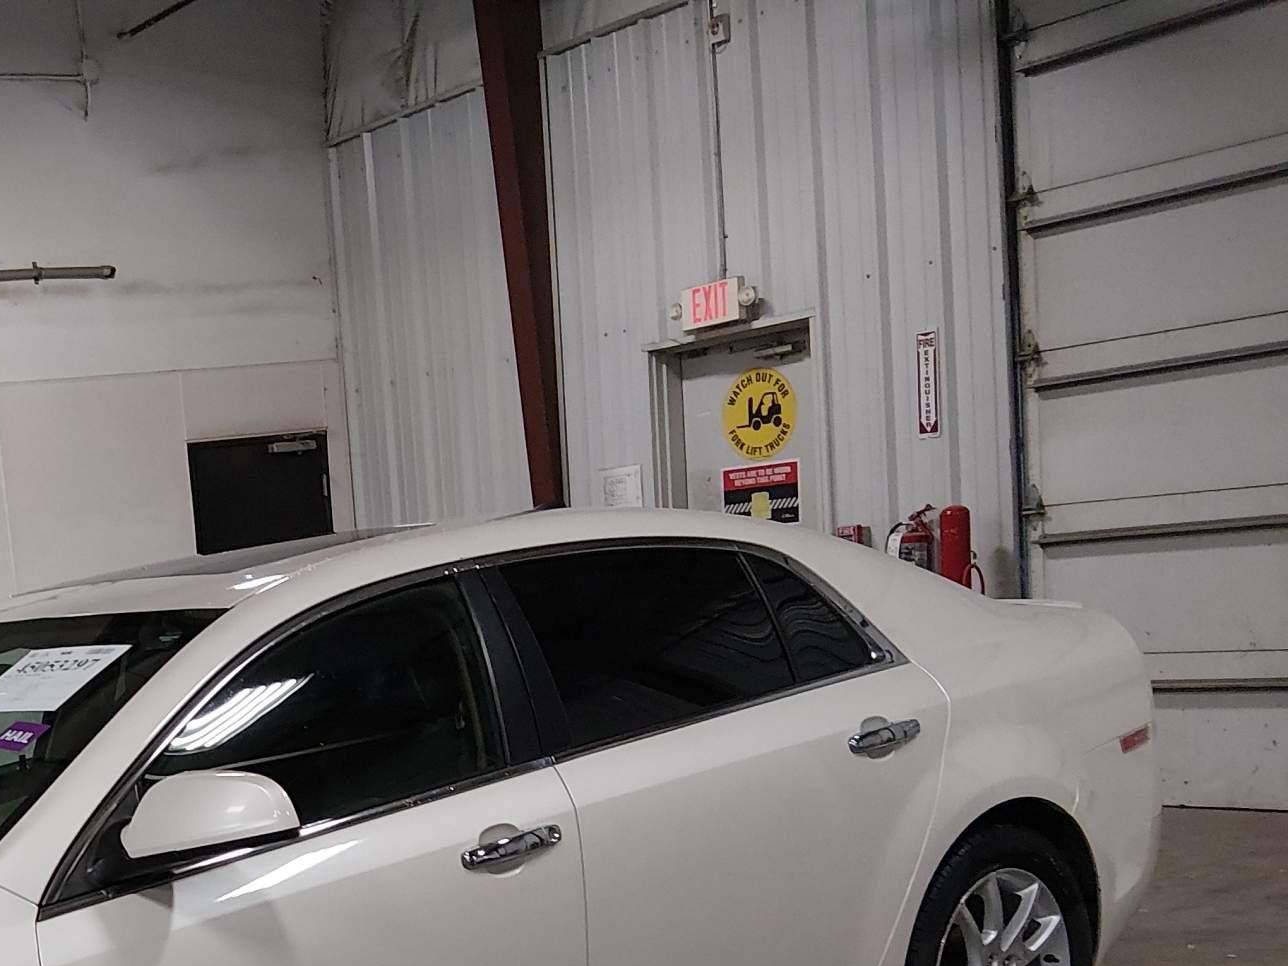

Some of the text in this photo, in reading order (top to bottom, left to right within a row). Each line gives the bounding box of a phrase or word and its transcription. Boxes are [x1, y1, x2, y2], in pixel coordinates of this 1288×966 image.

[692, 281, 728, 323] EXIT
[918, 337, 935, 348] FIRE
[727, 372, 790, 406] WATCH OUT FOR
[728, 423, 791, 456] FORK LIFT TRUCKS
[0, 729, 34, 744] HAIL
